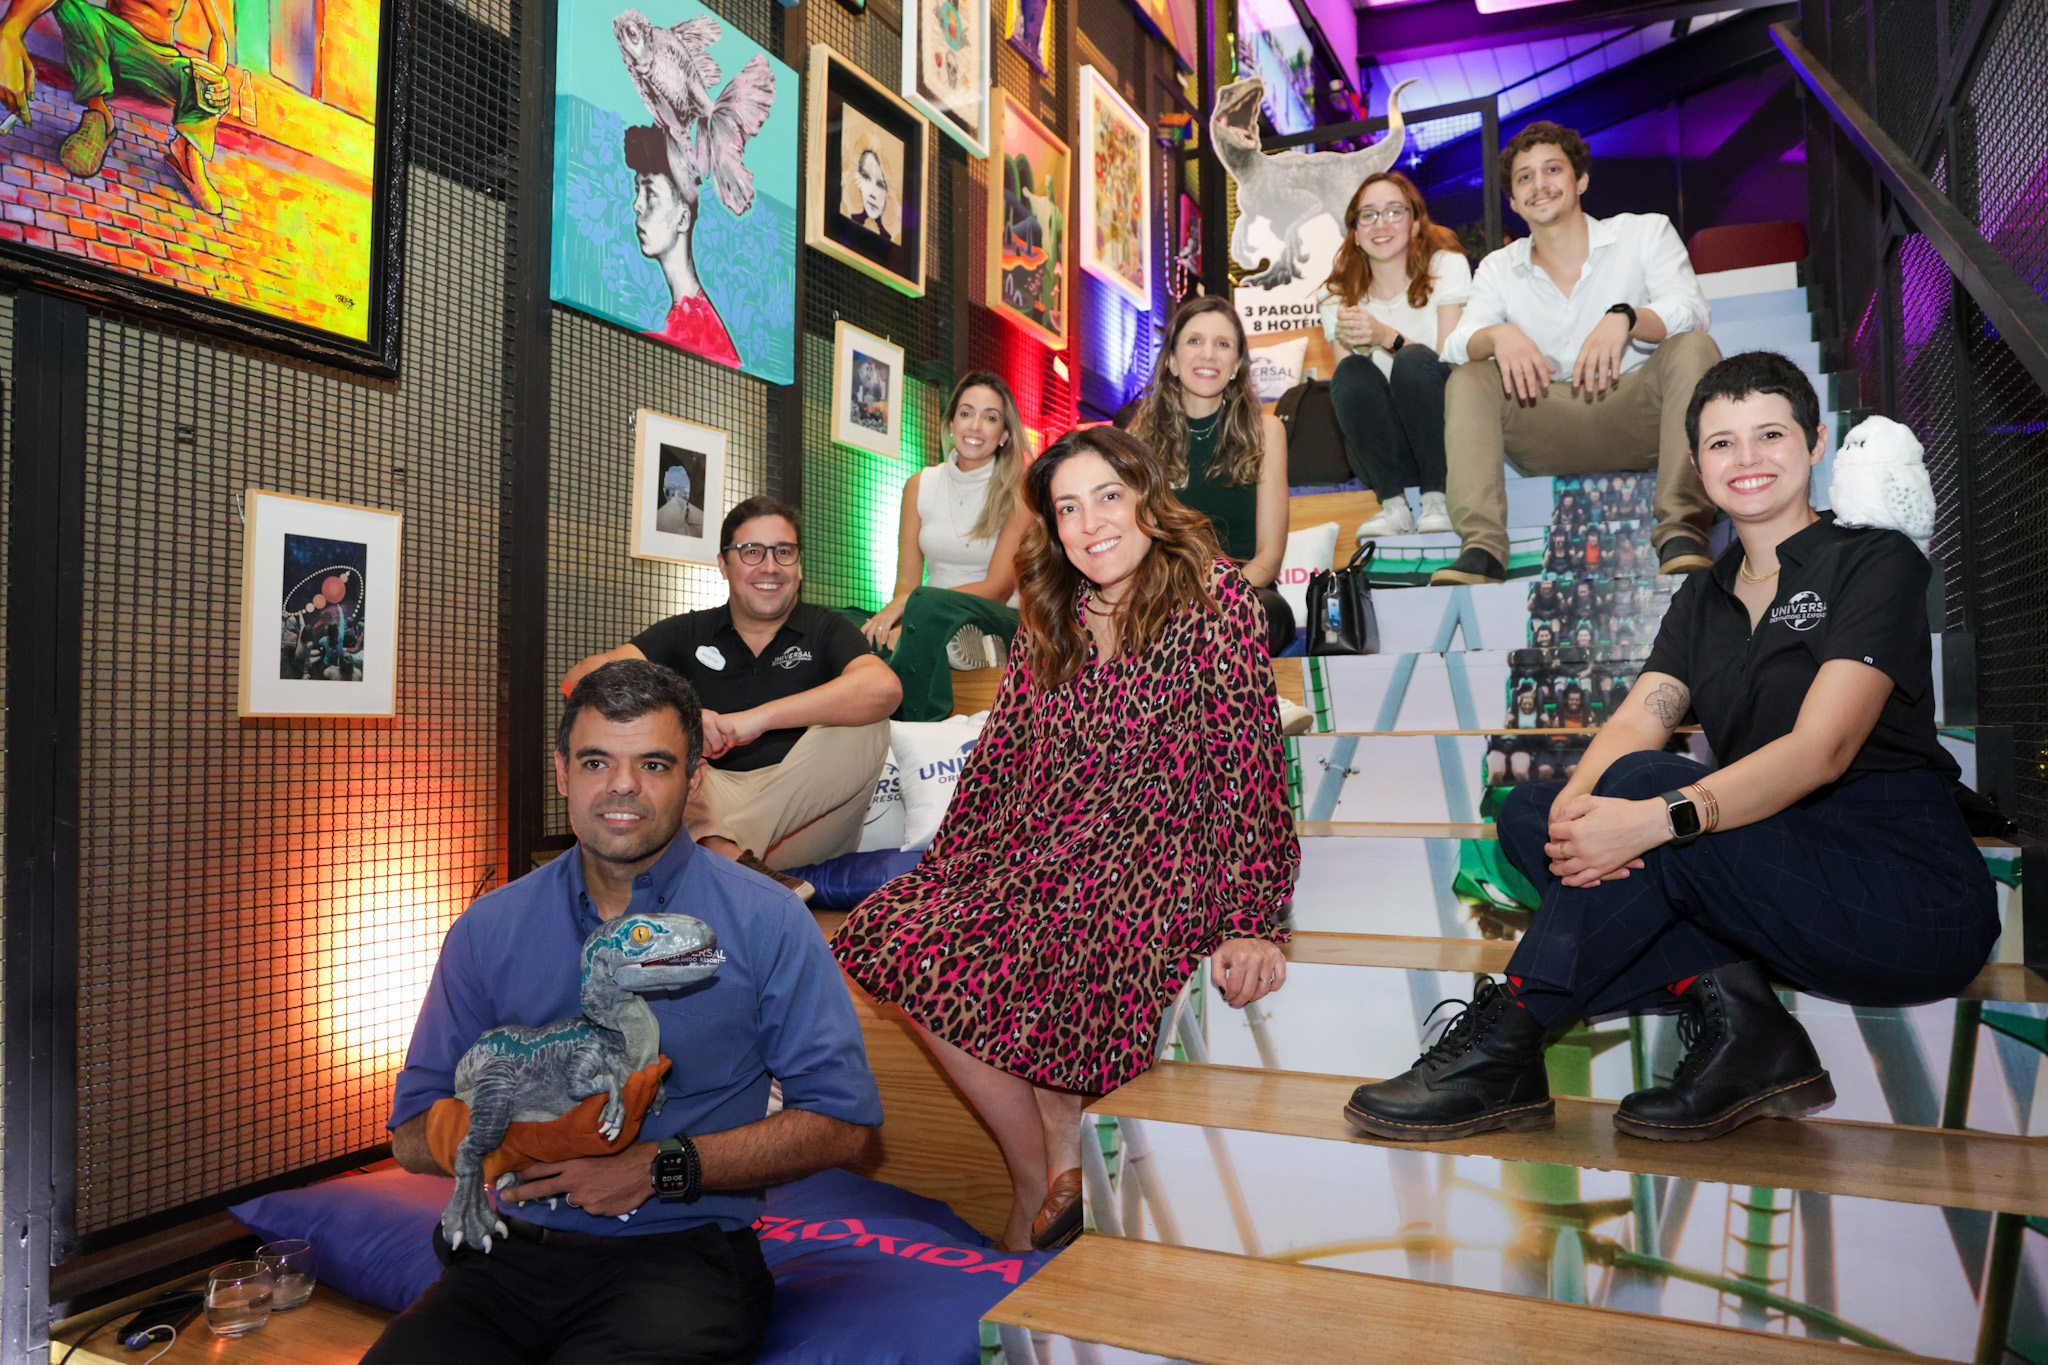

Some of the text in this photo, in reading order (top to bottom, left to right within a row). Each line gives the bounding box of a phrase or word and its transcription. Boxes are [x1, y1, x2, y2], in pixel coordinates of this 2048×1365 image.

[1245, 306, 1253, 317] 3
[1253, 321, 1262, 331] 8
[1251, 367, 1293, 377] ERSAL
[873, 793, 902, 804] RESO
